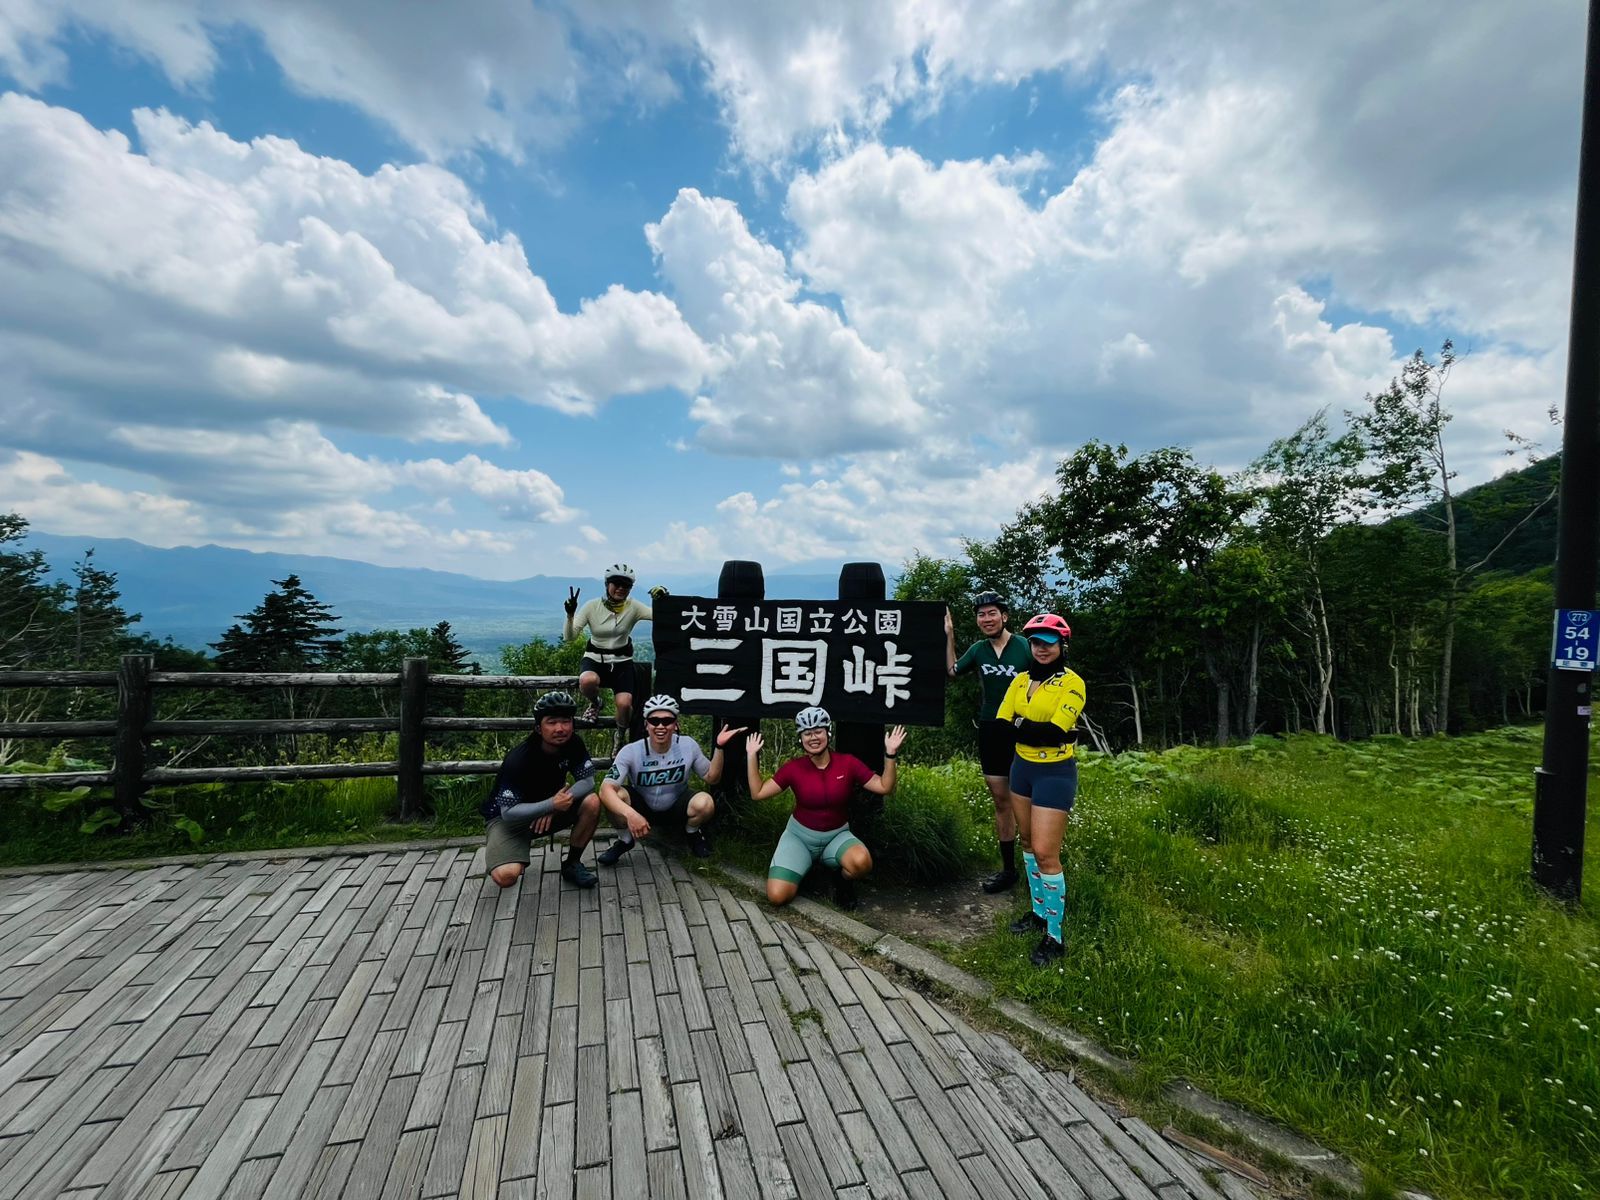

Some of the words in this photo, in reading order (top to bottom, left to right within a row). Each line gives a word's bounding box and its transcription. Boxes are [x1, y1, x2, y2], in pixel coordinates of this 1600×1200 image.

[680, 605, 901, 636] 大雪山国立公園
[1572, 613, 1588, 622] 273
[1564, 626, 1590, 640] 54
[1563, 646, 1589, 660] 19
[680, 637, 913, 709] 三国峠
